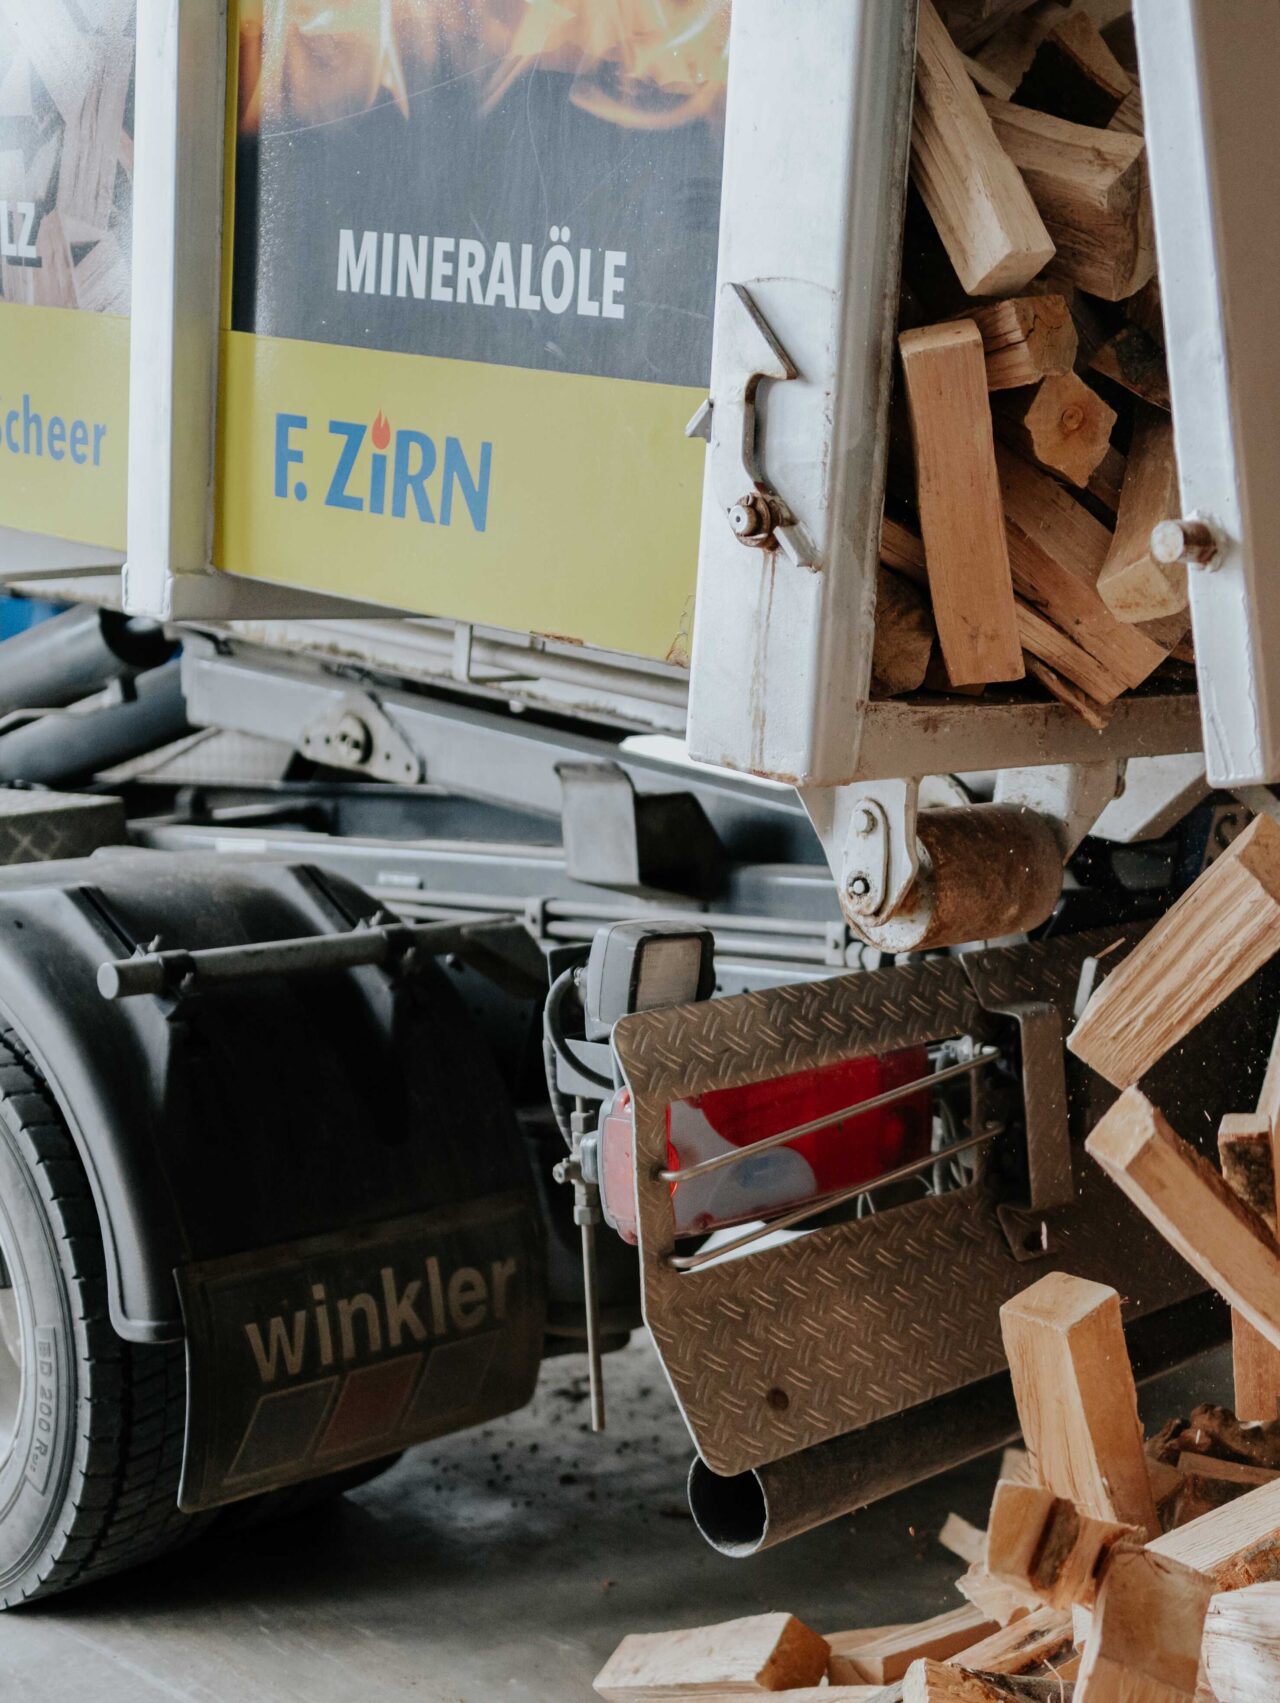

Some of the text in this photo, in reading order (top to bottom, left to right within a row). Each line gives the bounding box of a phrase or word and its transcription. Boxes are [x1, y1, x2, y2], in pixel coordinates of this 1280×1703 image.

[336, 224, 627, 320] MINERALÖLE
[0, 394, 107, 467] cheer
[273, 412, 308, 502] F.
[244, 1255, 517, 1383] winkler
[37, 1385, 53, 1435] 200
